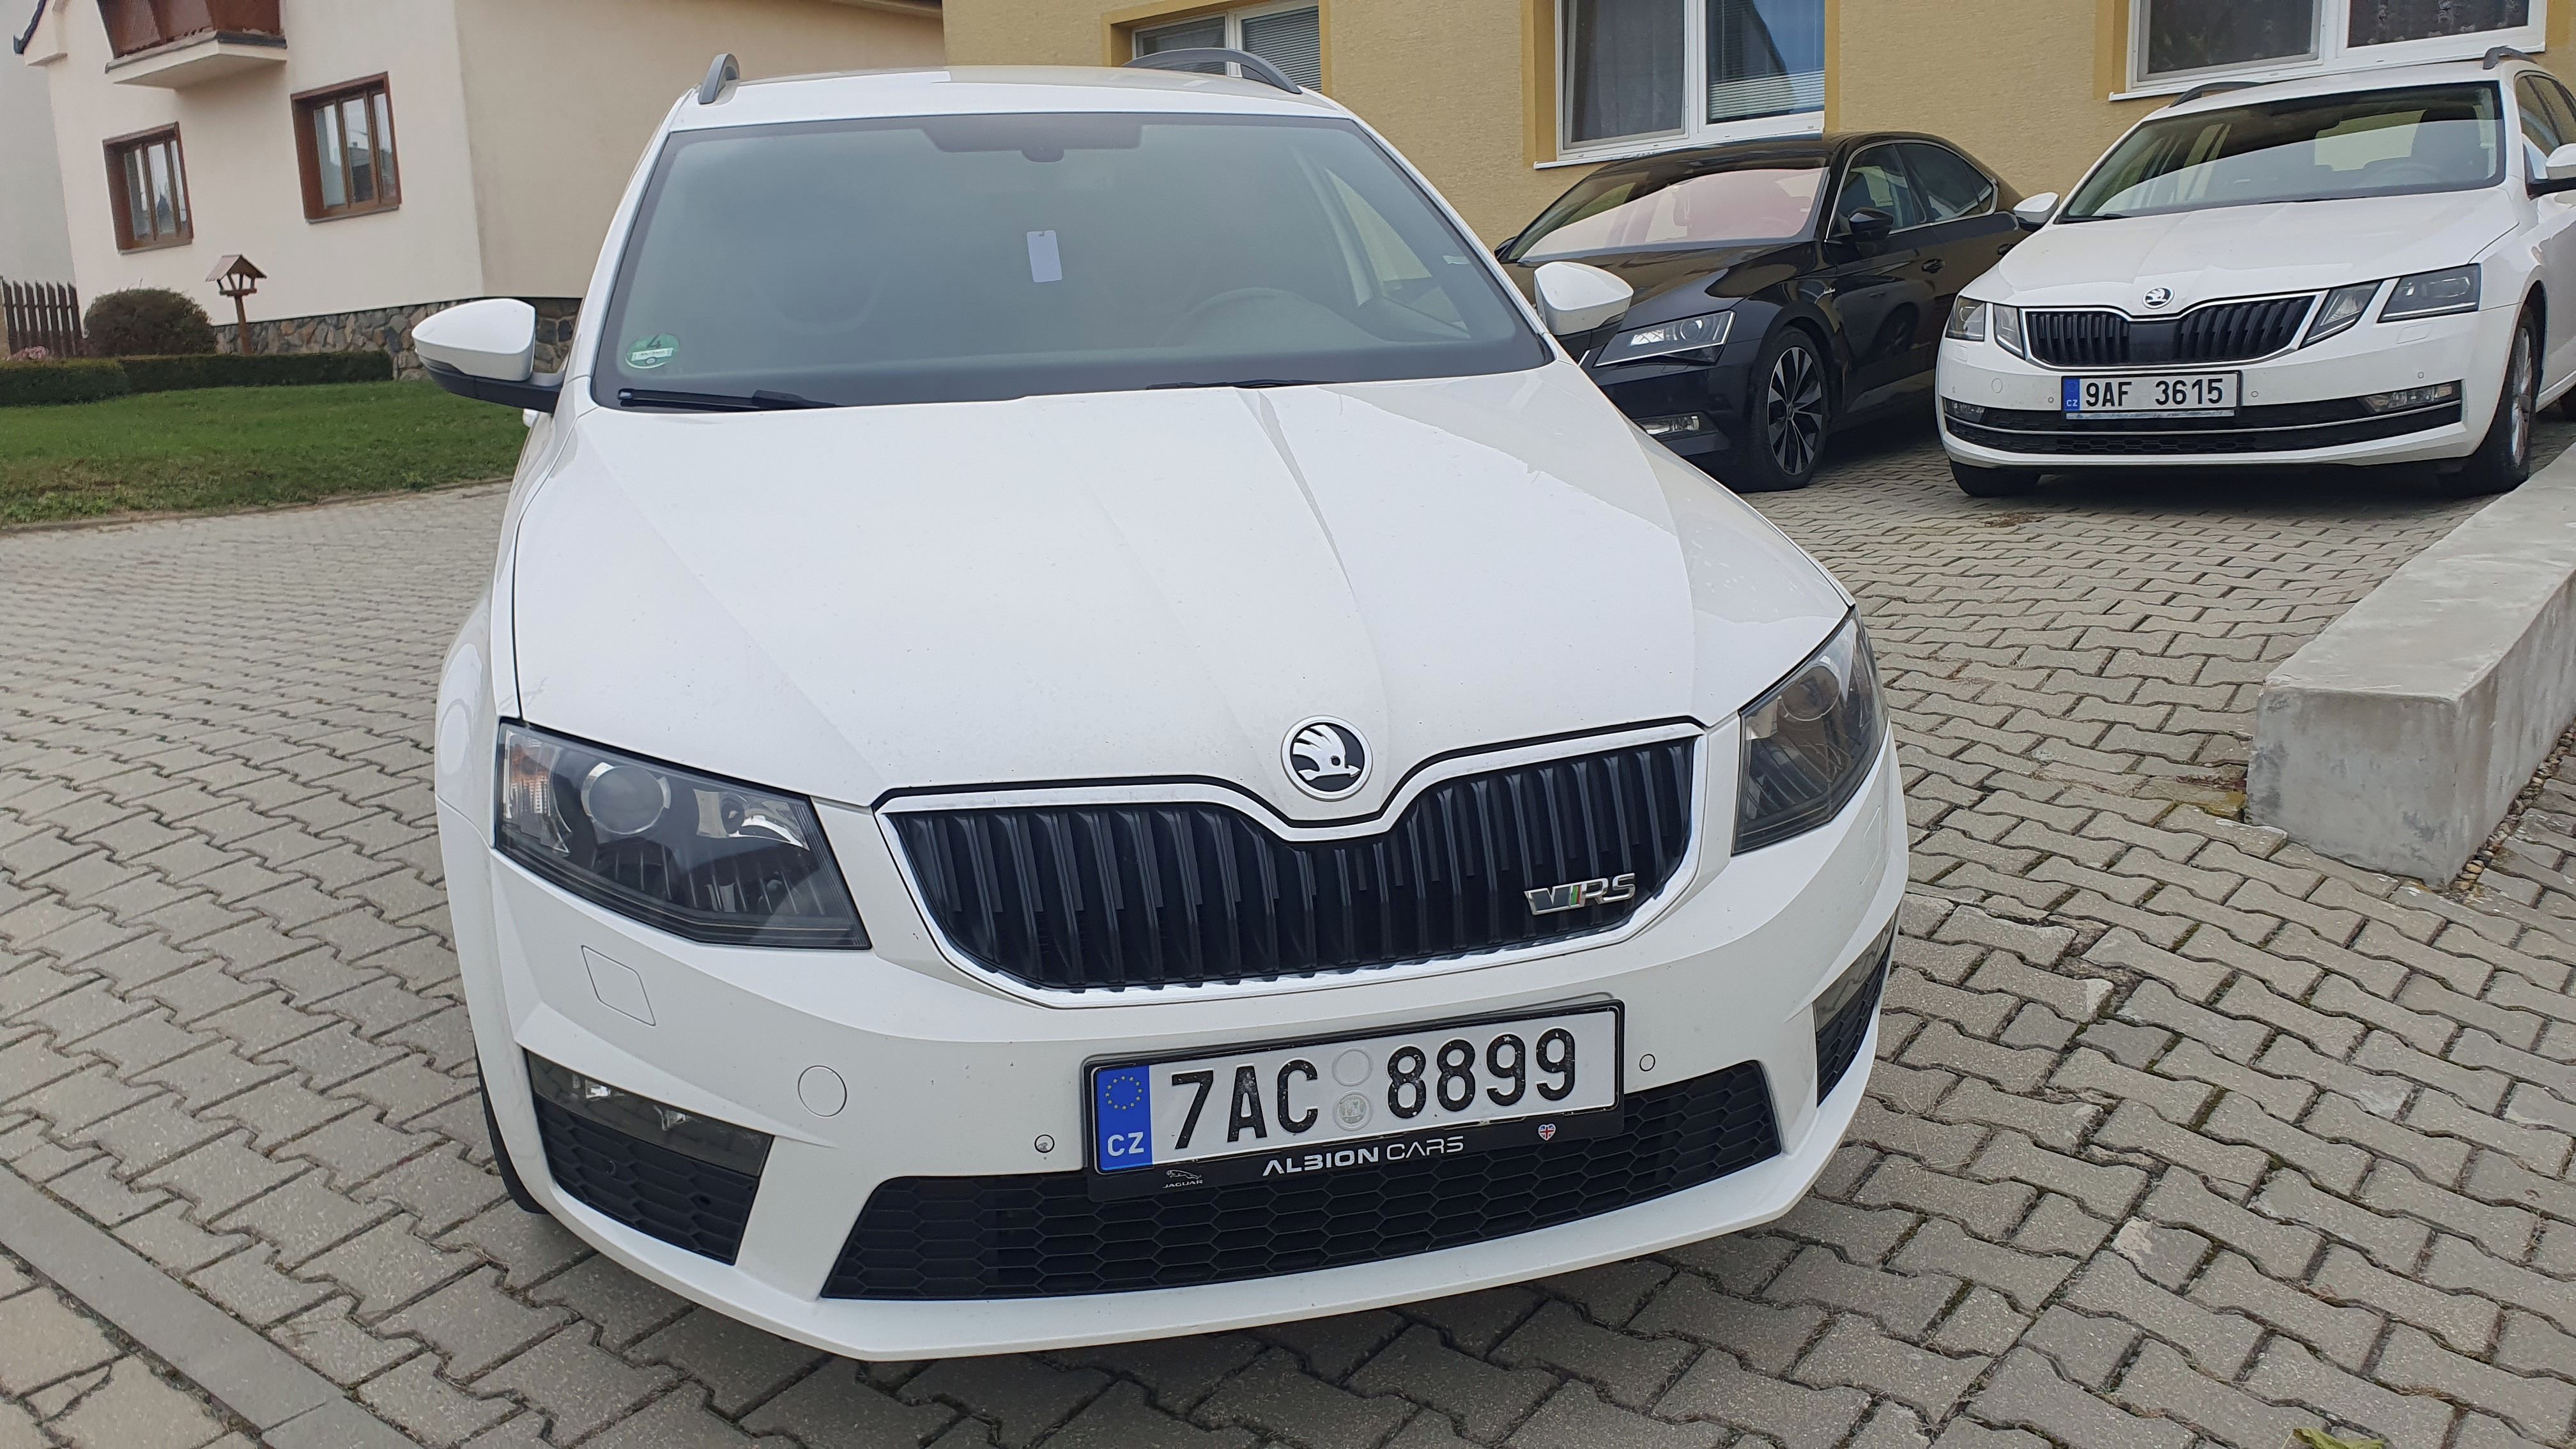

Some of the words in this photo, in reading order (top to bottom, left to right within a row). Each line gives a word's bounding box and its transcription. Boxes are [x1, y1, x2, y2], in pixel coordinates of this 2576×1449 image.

[2085, 381, 2133, 407] 9AF
[2155, 378, 2223, 406] 3615
[1171, 1059, 1319, 1151] 7AC
[1386, 1027, 1575, 1119] 8899
[1107, 1131, 1145, 1156] CZ
[1262, 1146, 1379, 1177] ALBION
[1386, 1135, 1464, 1161] CARS
[1162, 1179, 1204, 1189] JAGUAR
